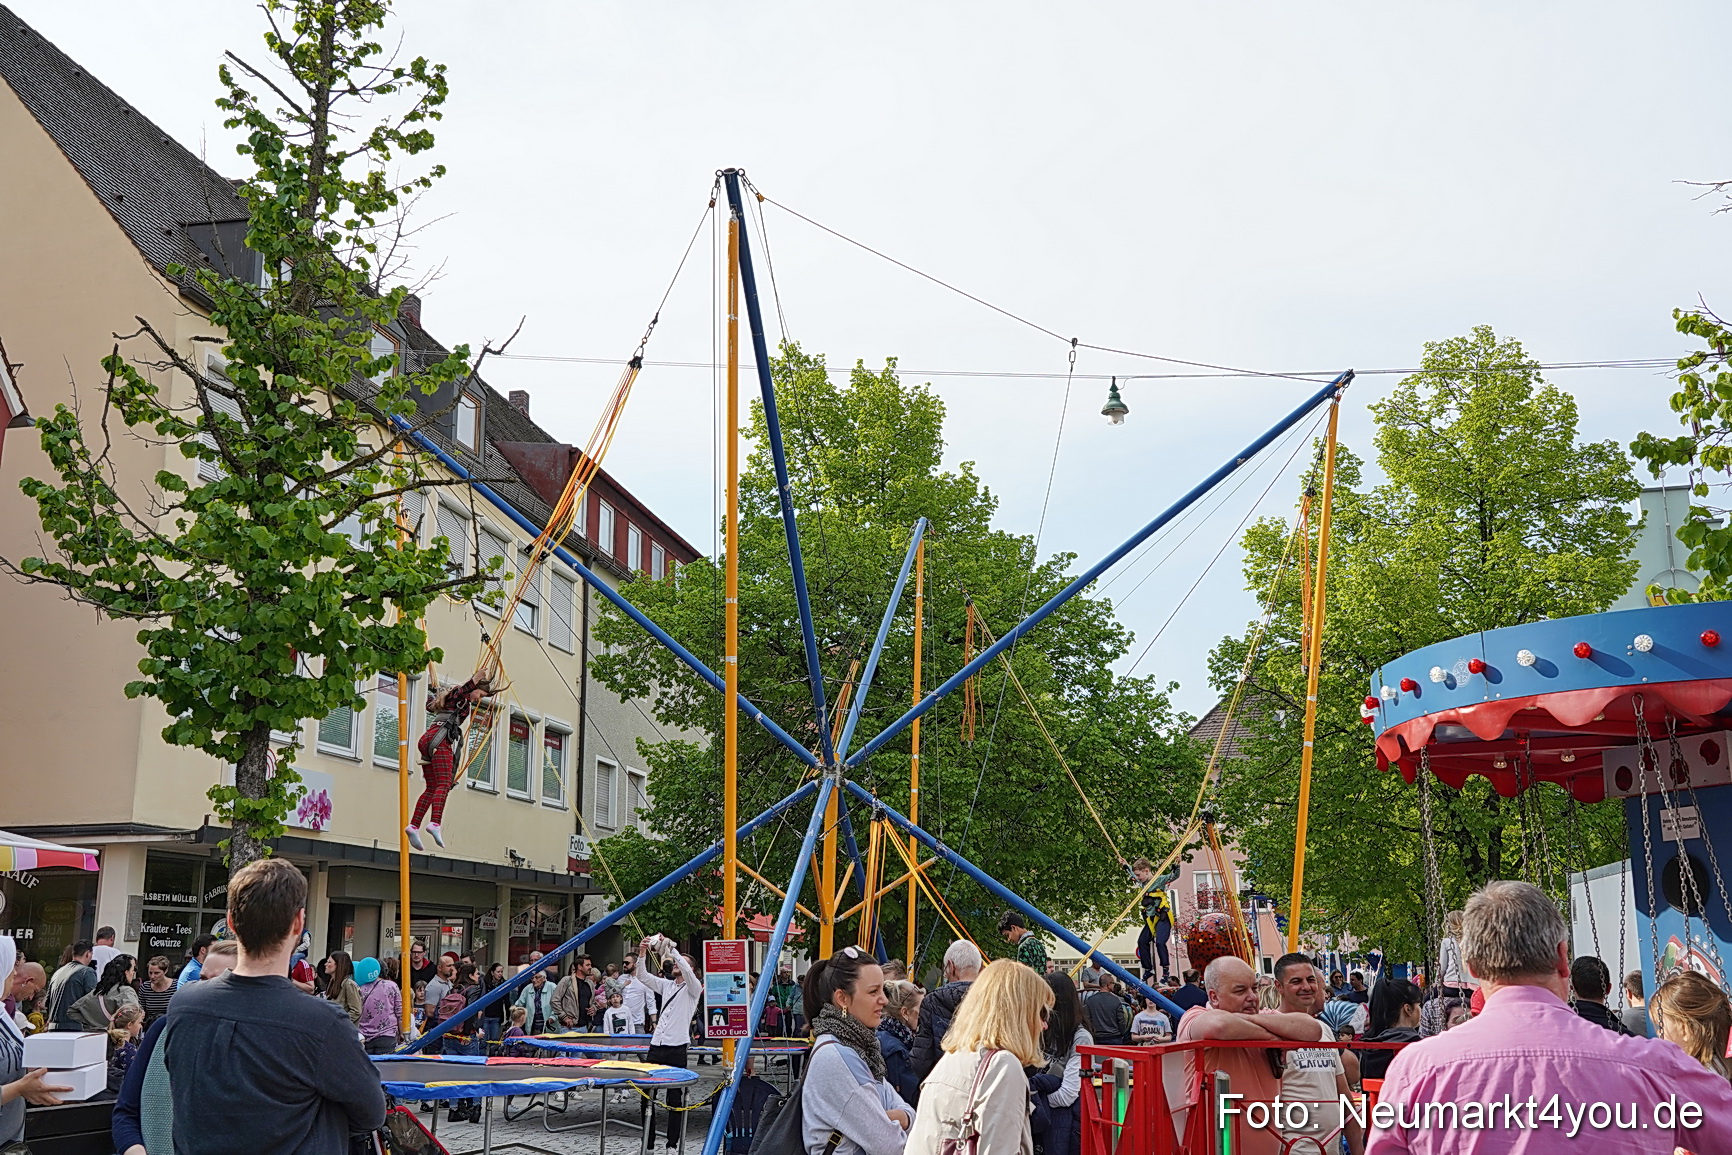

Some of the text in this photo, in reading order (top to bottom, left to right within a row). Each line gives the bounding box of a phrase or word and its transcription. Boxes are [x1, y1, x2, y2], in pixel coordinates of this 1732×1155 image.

[570, 836, 584, 851] Foto
[1, 870, 40, 889] KAUF
[172, 894, 198, 904] MÜLLER
[140, 923, 193, 934] Kräuter Tees
[386, 928, 394, 938] 26
[150, 936, 181, 948] Gewürze
[368, 970, 379, 979] 60
[730, 1028, 748, 1036] Euro
